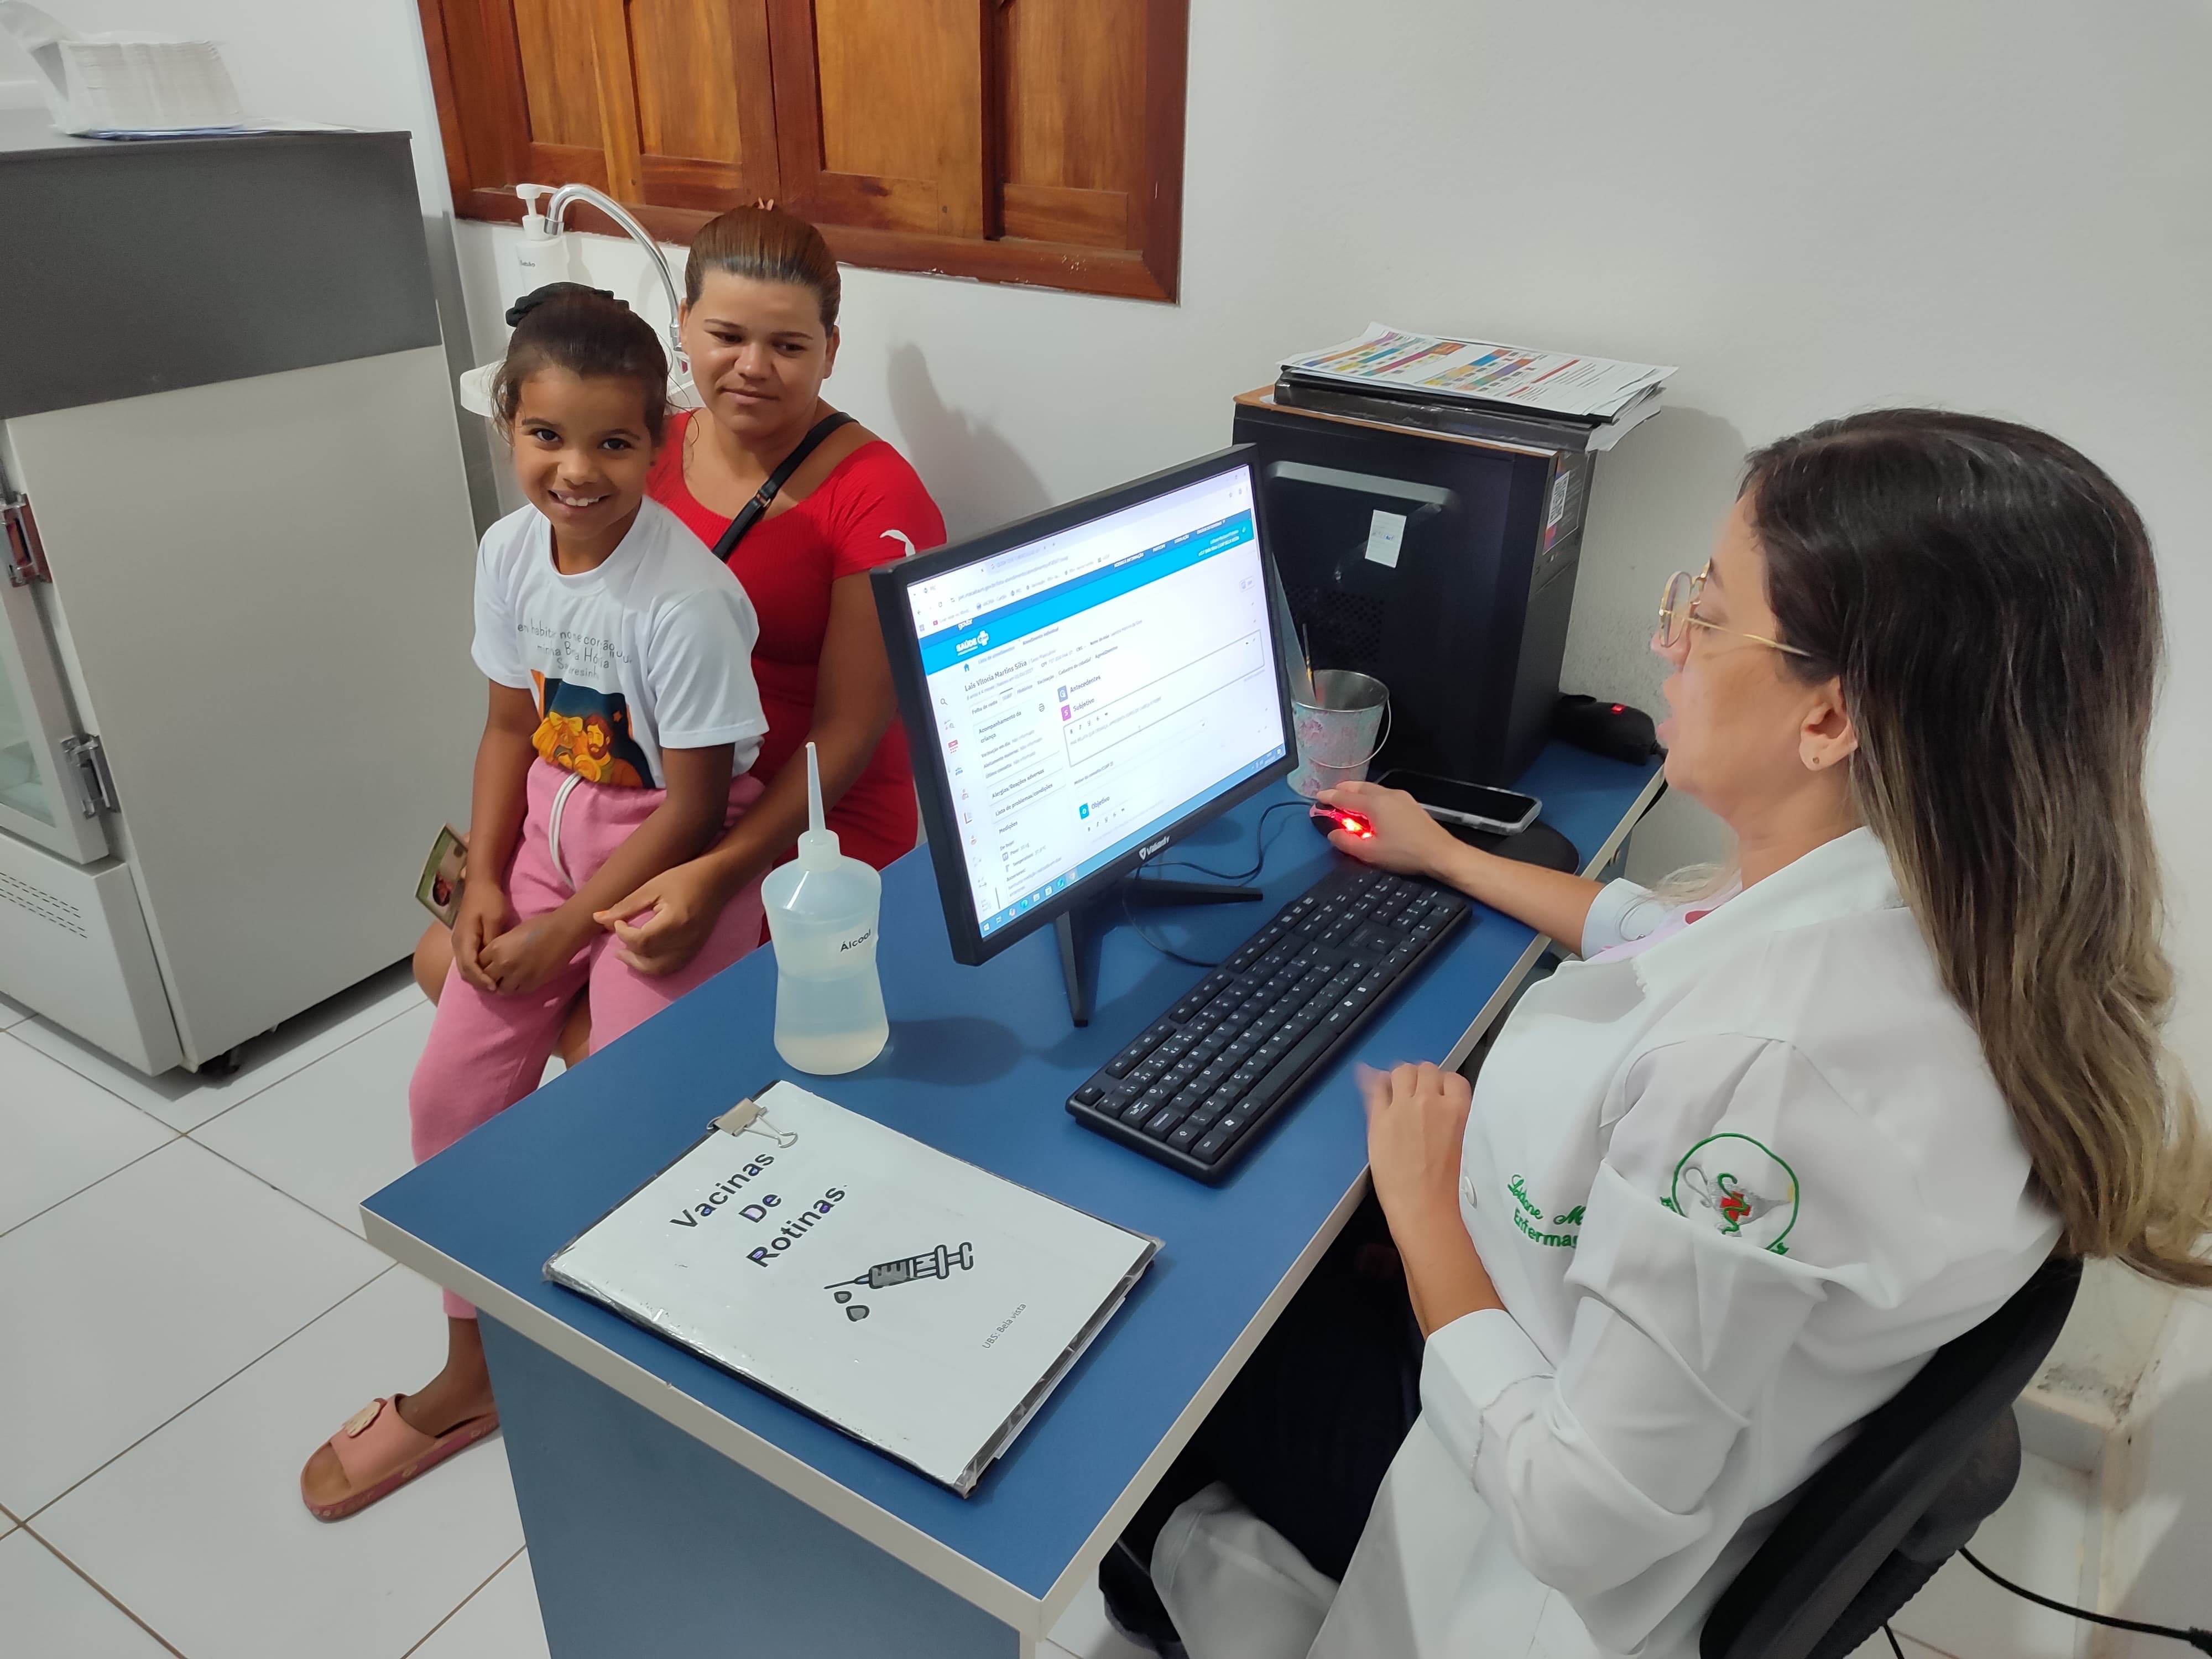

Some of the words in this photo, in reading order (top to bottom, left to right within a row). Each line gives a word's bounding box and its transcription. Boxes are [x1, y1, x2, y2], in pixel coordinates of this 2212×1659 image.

[994, 667, 1014, 679] Martins
[1070, 675, 1100, 693] Antecedentes
[979, 714, 1015, 734] Acompanhamento
[980, 733, 997, 743] criança
[1091, 796, 1110, 810] Objetivo
[840, 929, 871, 952] Álcool
[670, 1154, 775, 1227] Vacinas
[738, 1194, 781, 1223] De
[745, 1187, 846, 1268] Rotinas
[982, 1333, 1000, 1349] UBS:
[997, 1319, 1014, 1333] Bela
[1010, 1304, 1026, 1319] vista
